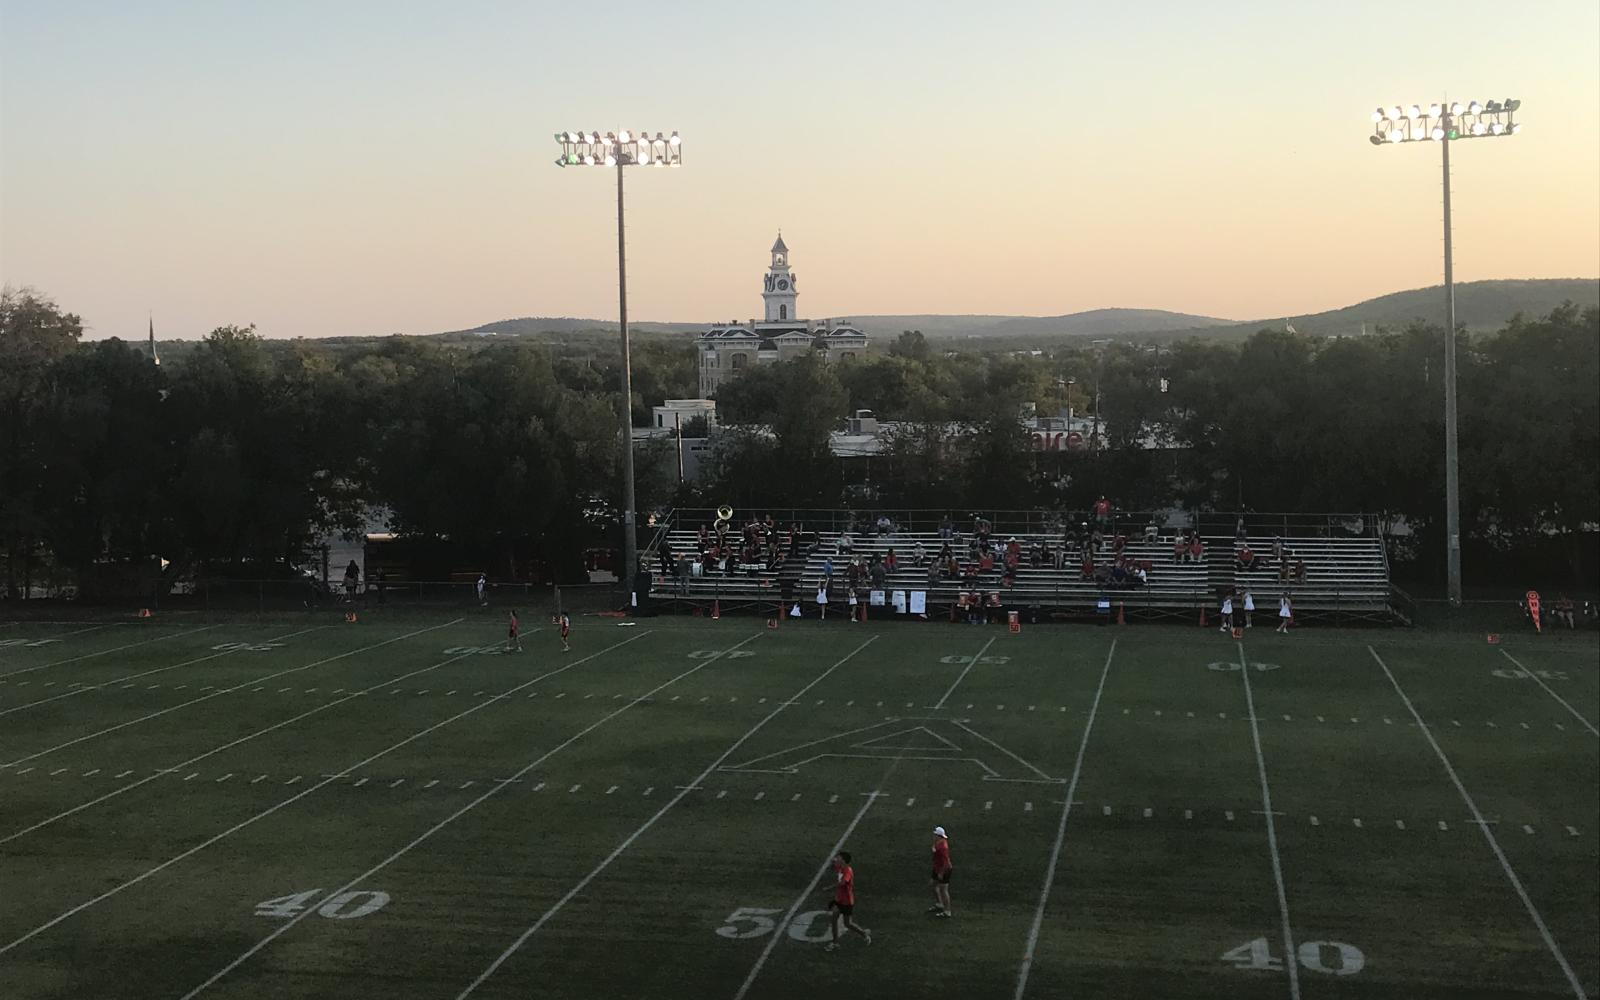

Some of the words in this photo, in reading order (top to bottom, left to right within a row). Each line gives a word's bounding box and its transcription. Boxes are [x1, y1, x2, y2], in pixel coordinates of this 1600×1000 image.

[1010, 624, 1019, 632] 50
[687, 650, 757, 659] 40
[939, 655, 1011, 664] 50
[1207, 661, 1281, 672] 40
[254, 888, 391, 919] 40
[715, 907, 848, 943] 50
[1219, 937, 1366, 977] 40
